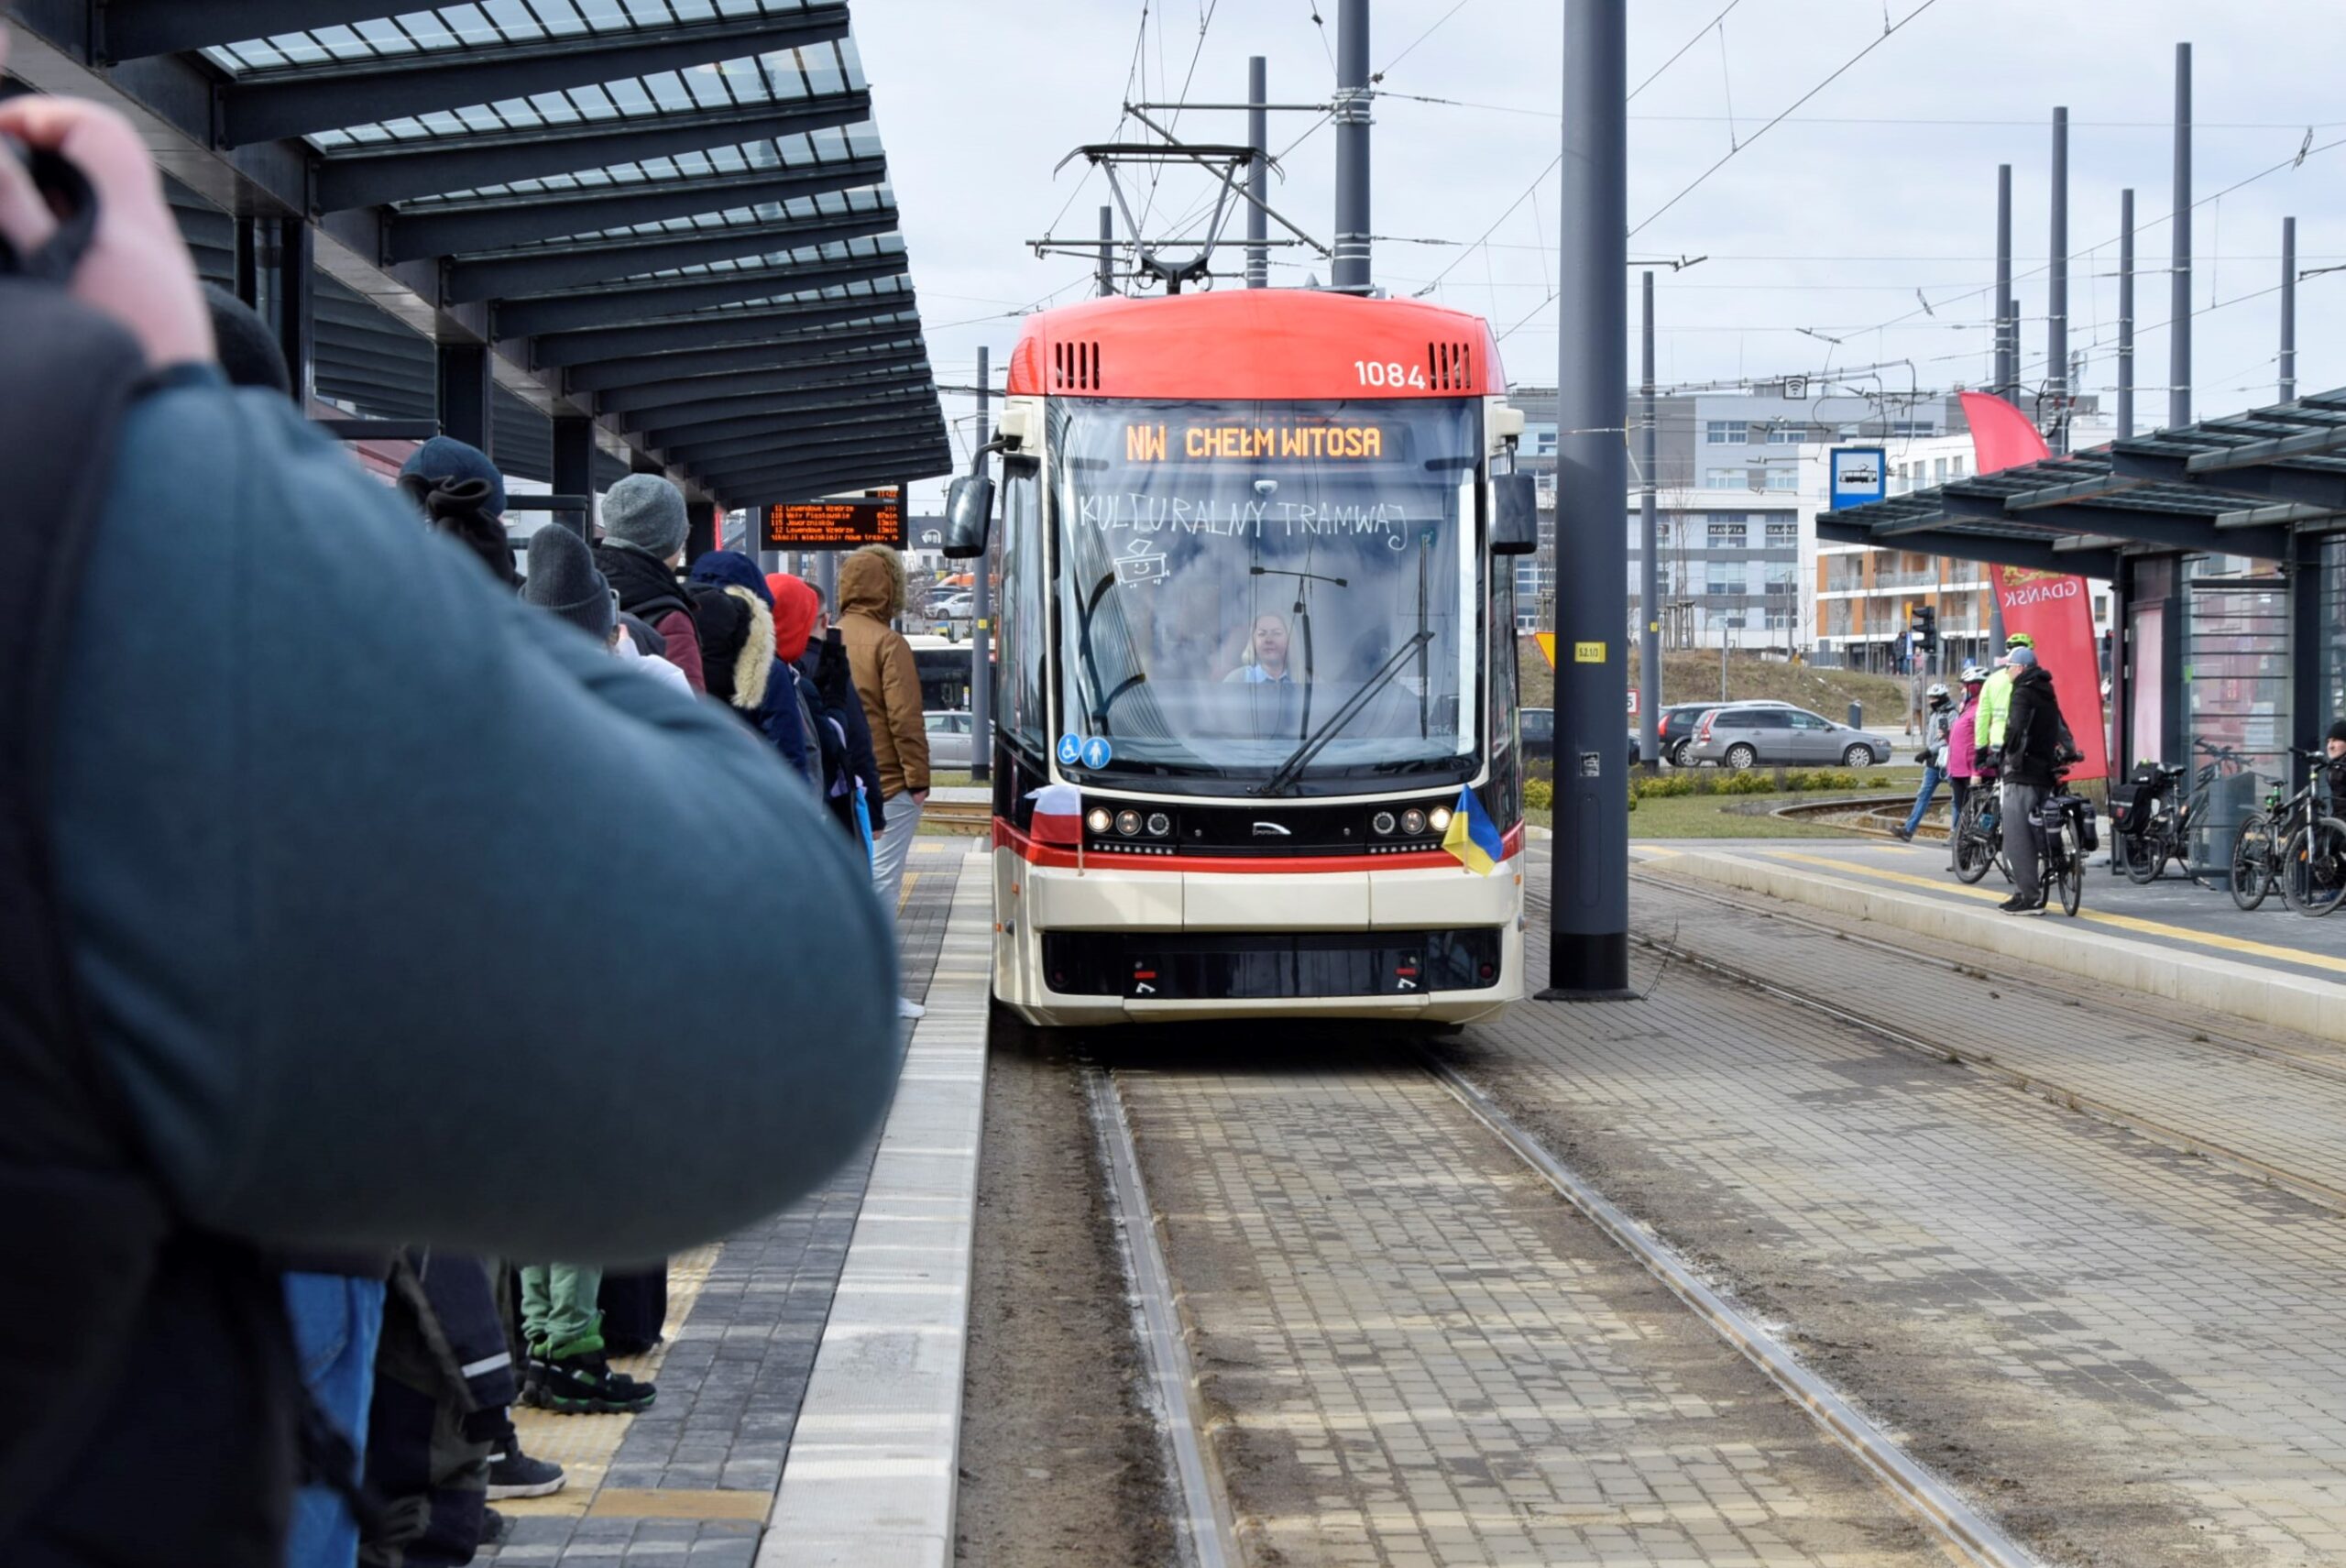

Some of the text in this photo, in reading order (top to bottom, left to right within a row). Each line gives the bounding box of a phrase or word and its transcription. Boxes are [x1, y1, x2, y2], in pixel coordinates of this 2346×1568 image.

[1354, 359, 1426, 389] 1084
[1126, 424, 1381, 461] NW CHEŁM WITOSA
[1080, 492, 1409, 551] KULTURALNY TRAMWAJ
